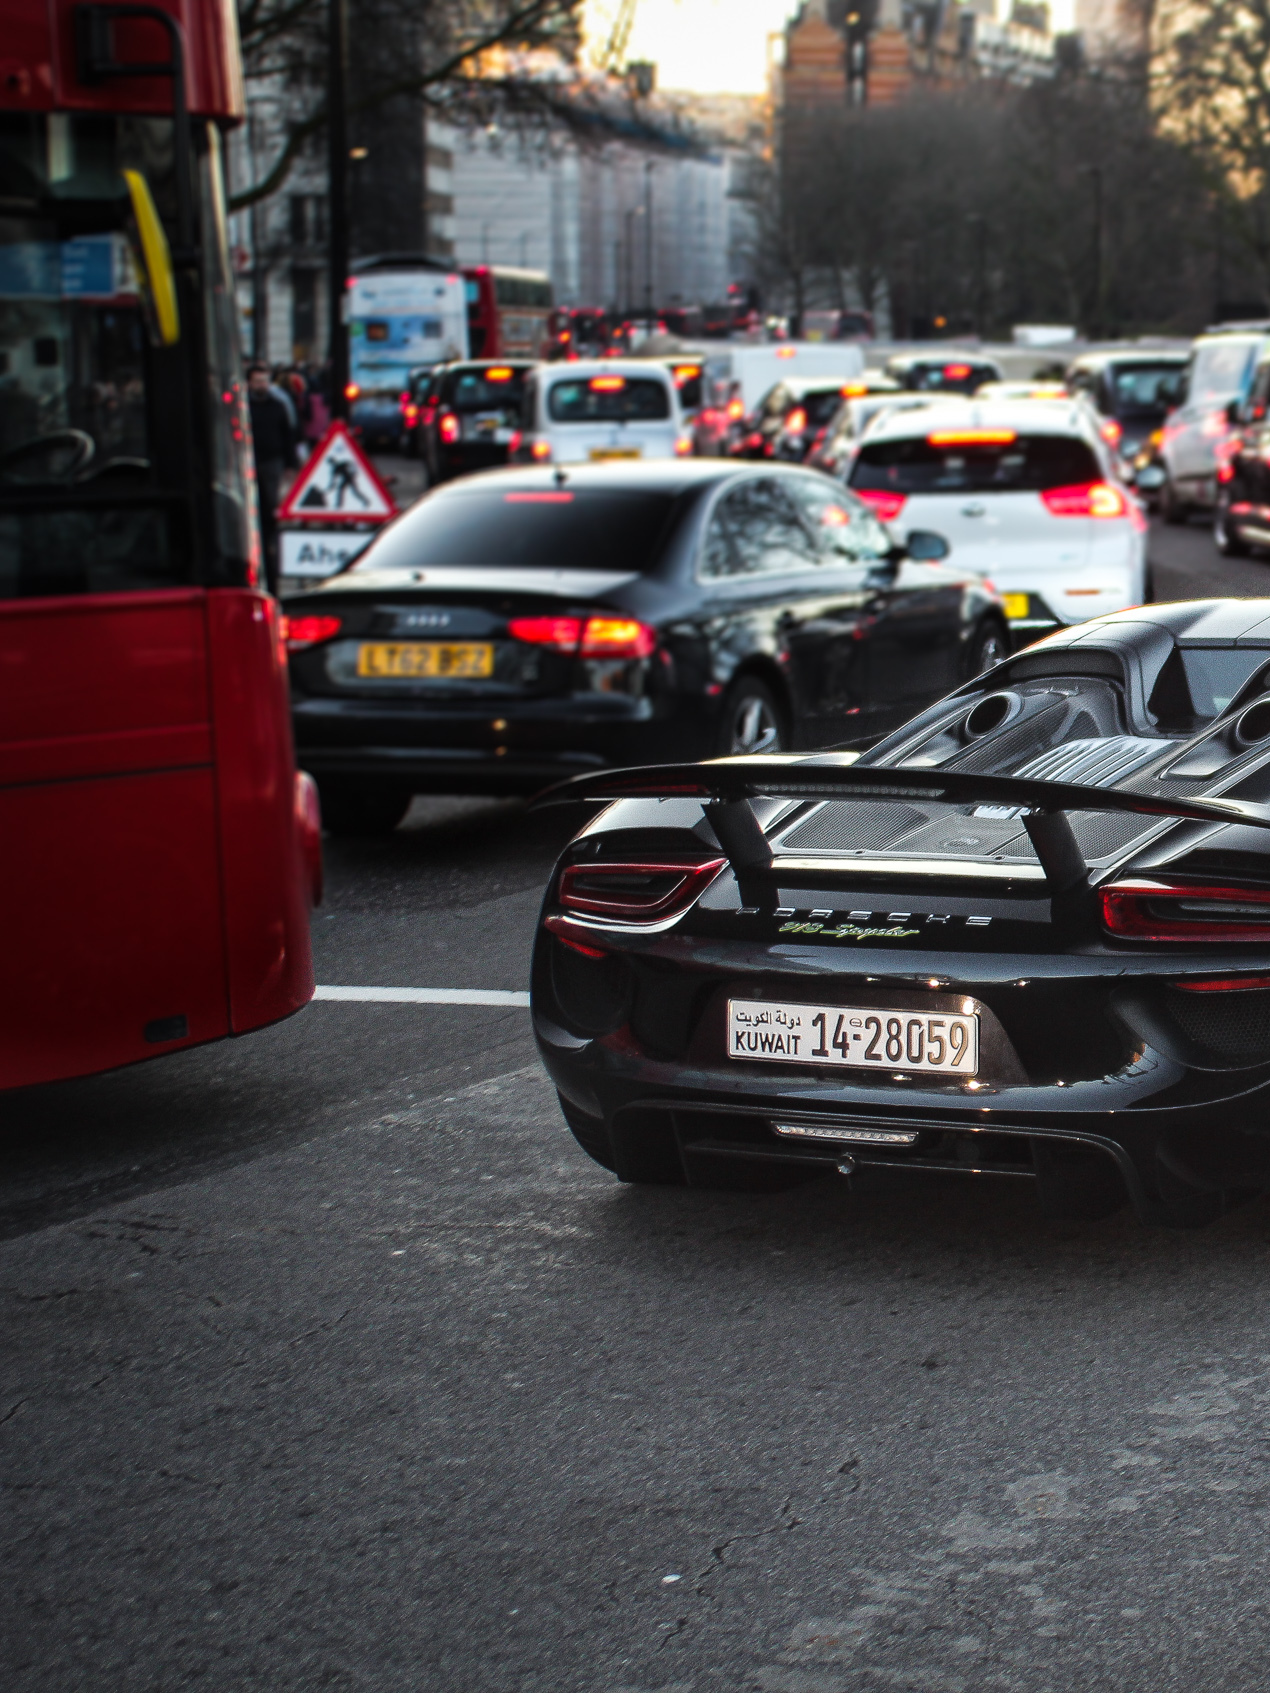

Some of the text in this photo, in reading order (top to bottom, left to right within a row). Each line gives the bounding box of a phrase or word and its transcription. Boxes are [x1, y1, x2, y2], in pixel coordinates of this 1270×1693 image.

[735, 1010, 801, 1030] دولة الكويت
[735, 1030, 801, 1056] KUWAIT
[811, 1011, 970, 1067] 14-28059
